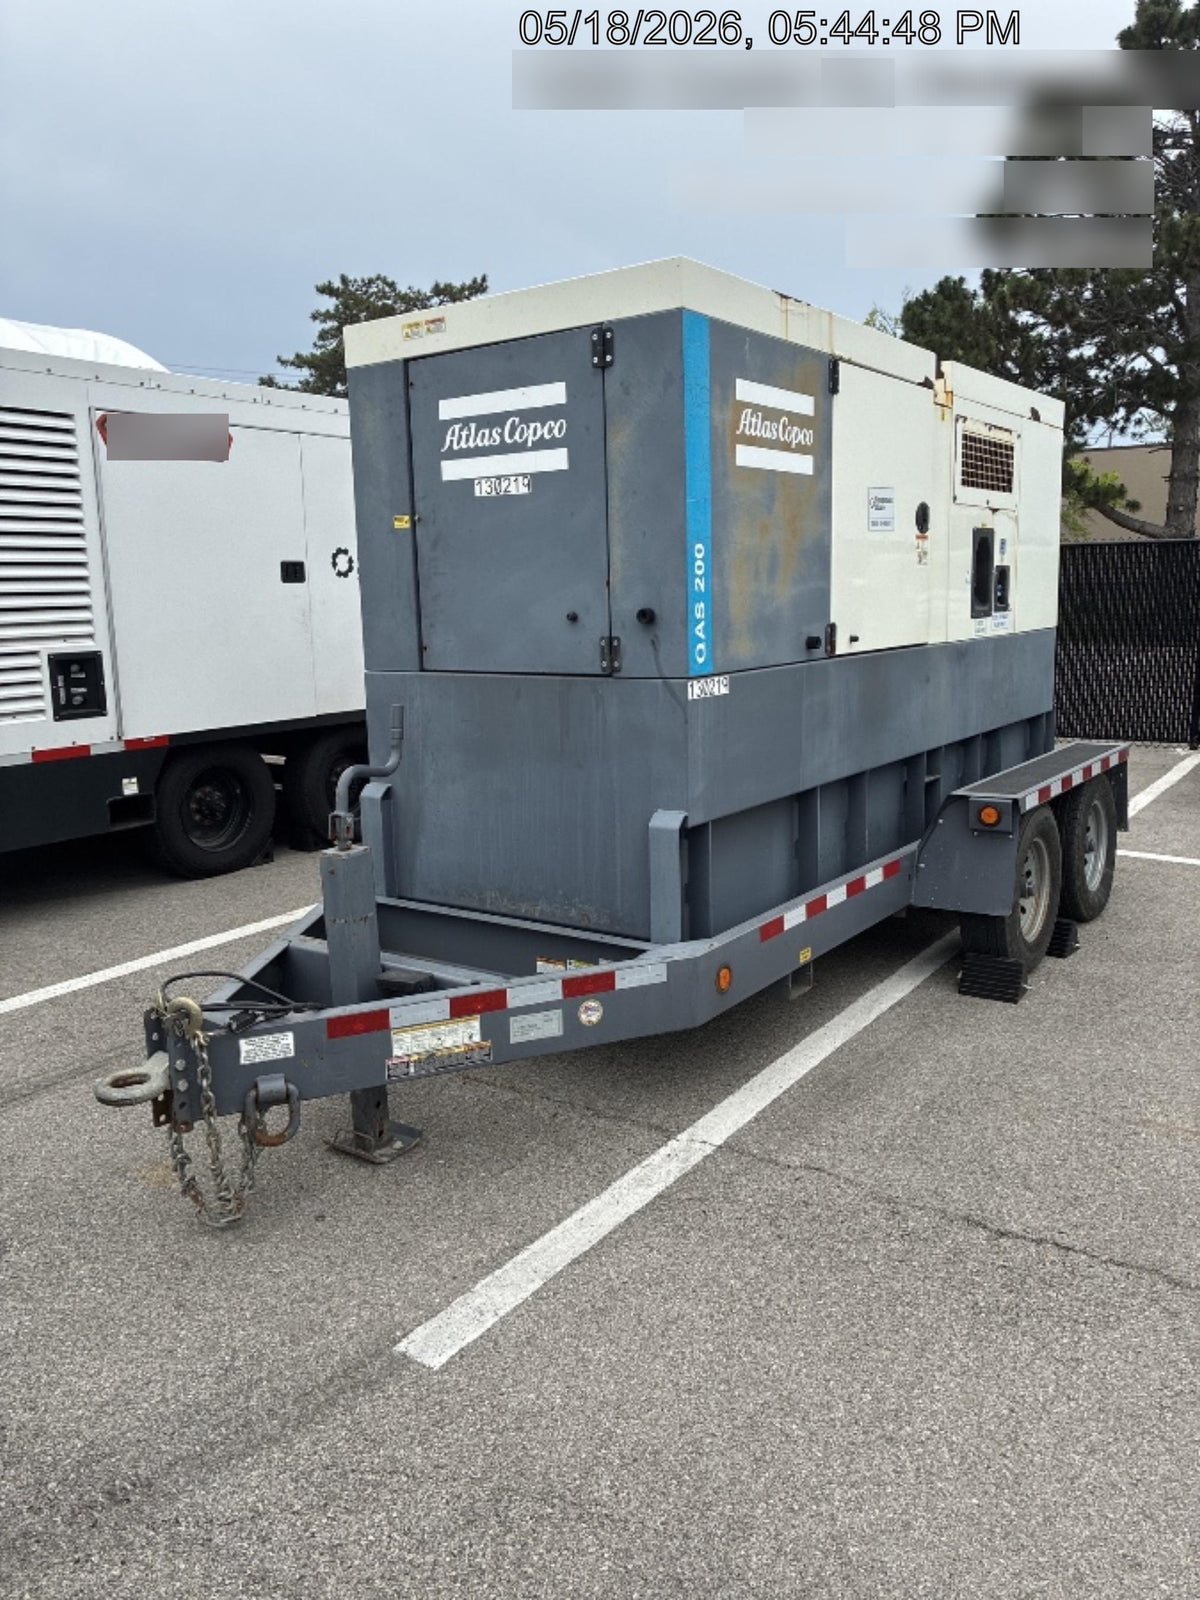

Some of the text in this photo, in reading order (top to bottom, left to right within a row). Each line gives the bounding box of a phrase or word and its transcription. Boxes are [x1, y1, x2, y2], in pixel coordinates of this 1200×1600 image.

[441, 416, 567, 453] Atlas Copco
[736, 408, 814, 449] Atlas Copco
[476, 475, 531, 496] 130219
[694, 543, 706, 665] QAS 200
